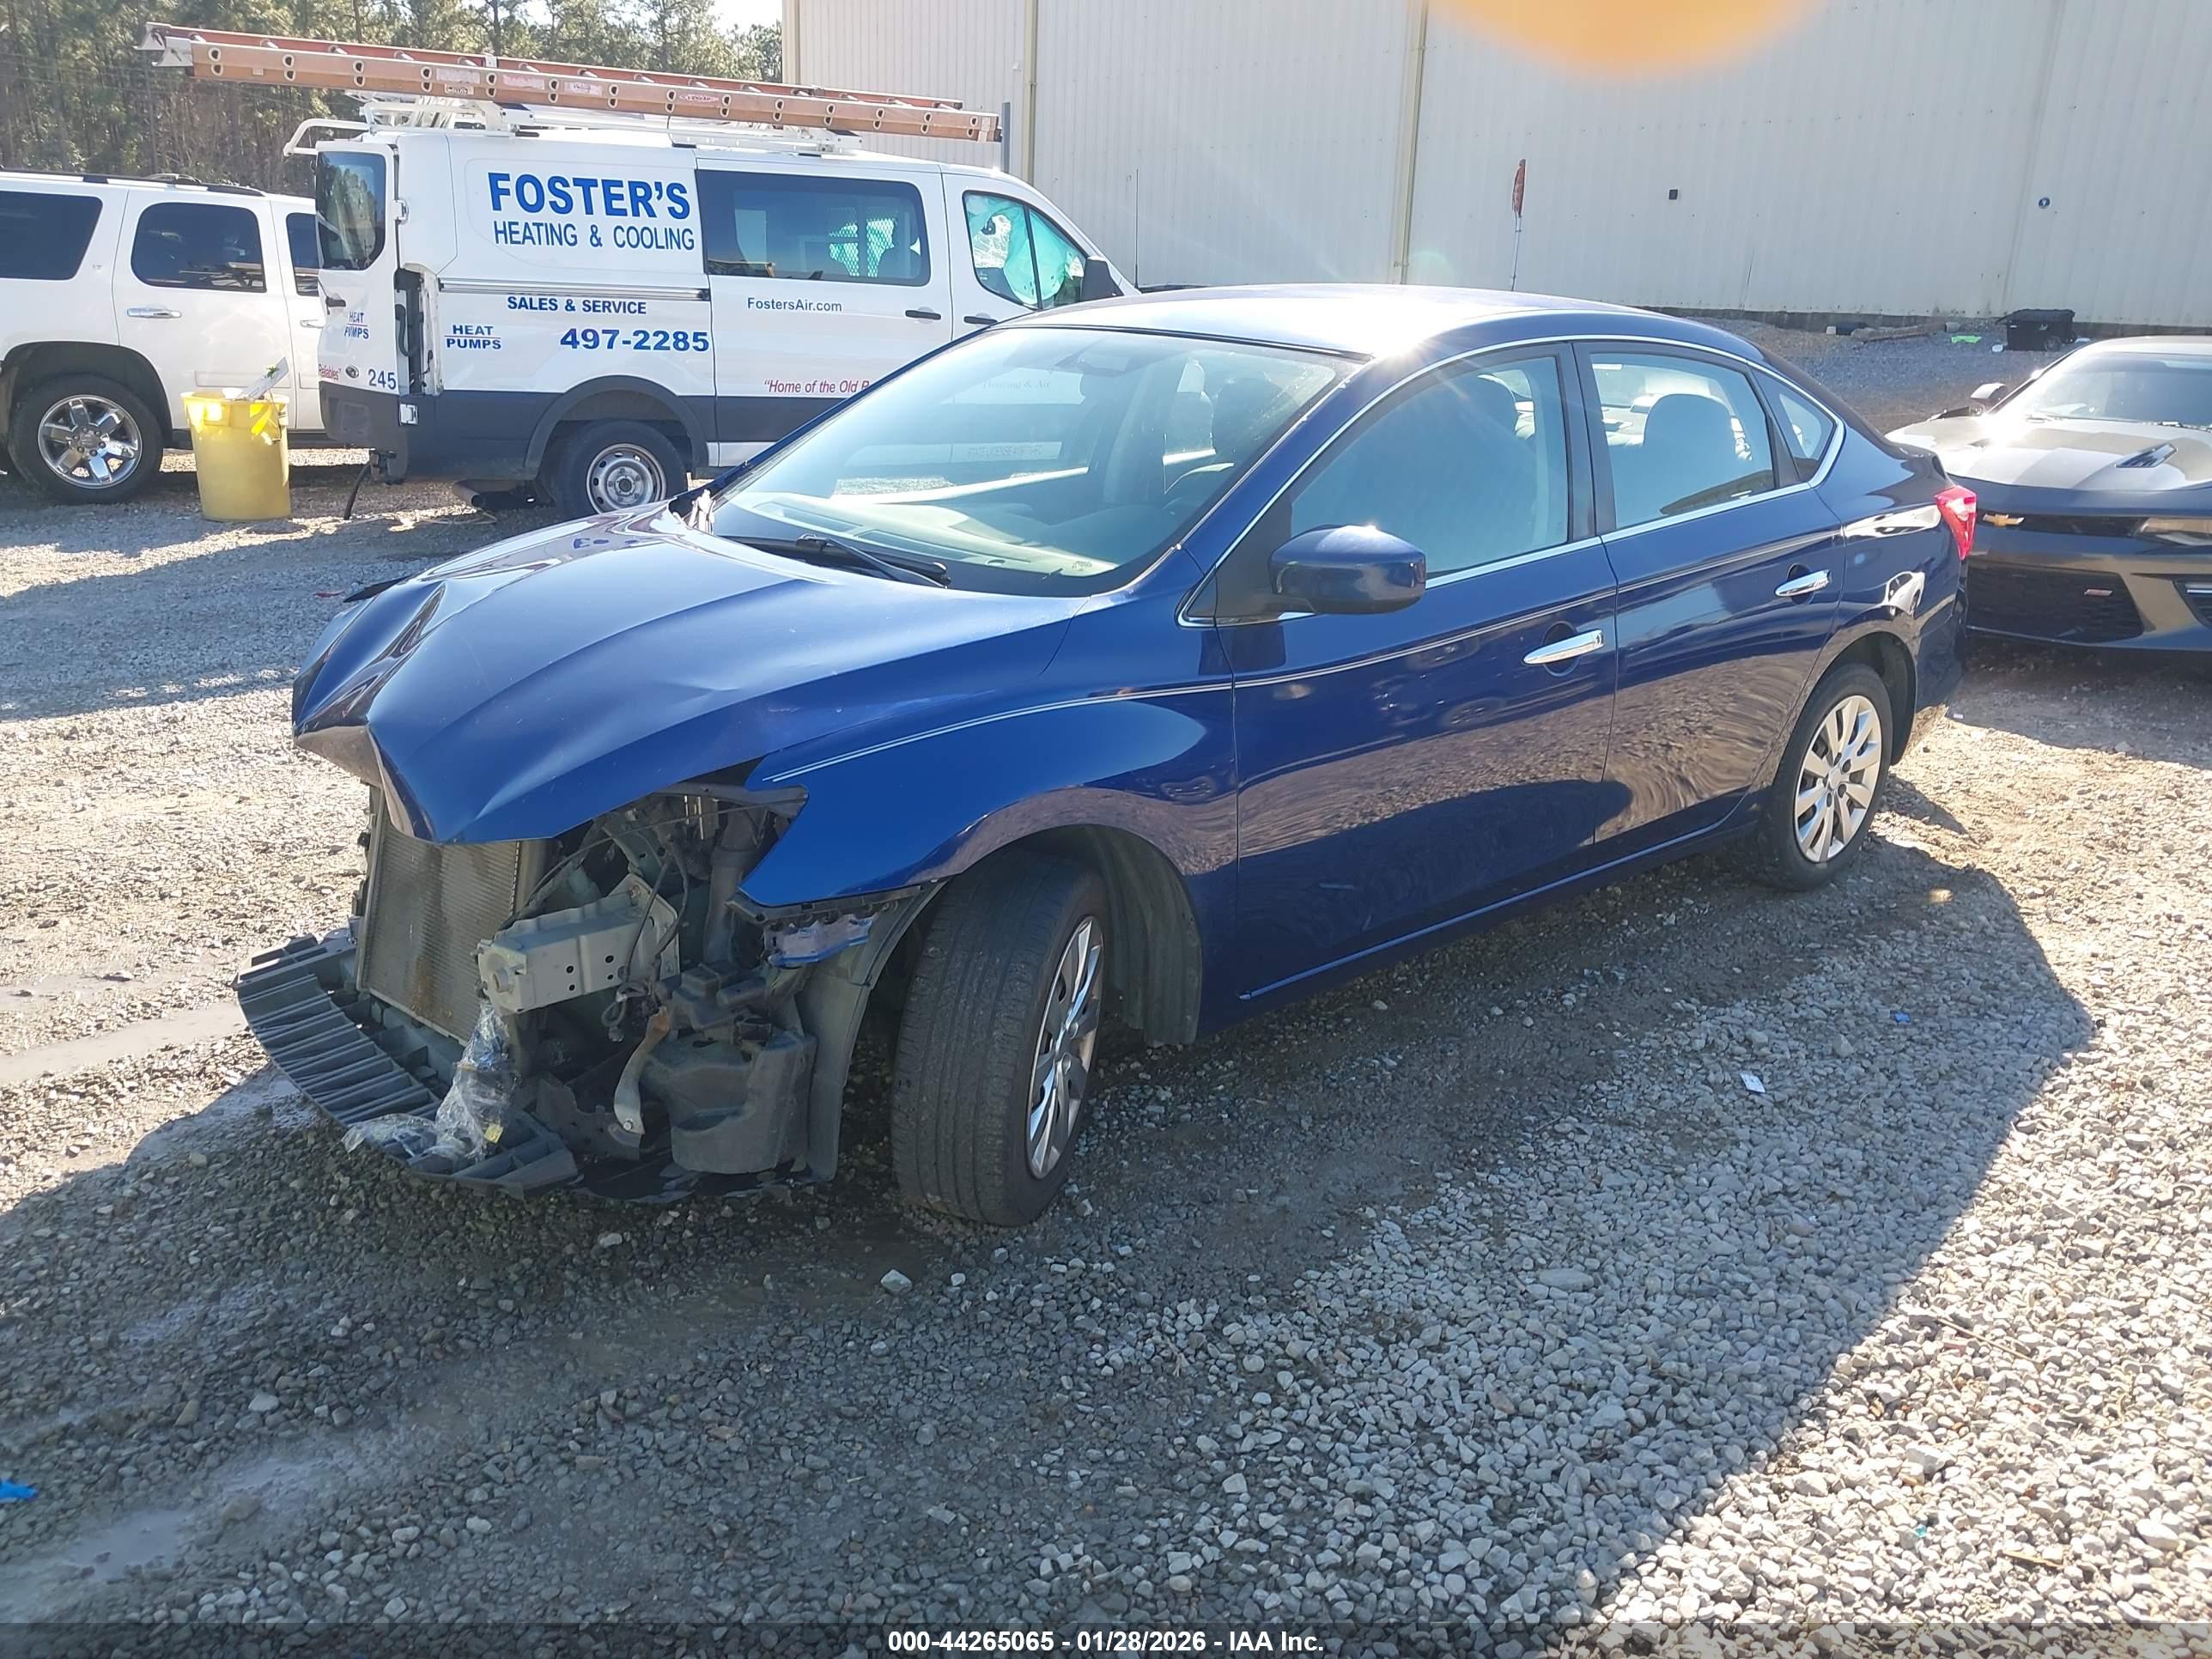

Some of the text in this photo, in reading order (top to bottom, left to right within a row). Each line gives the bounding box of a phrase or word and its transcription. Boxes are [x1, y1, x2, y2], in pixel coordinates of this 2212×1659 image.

[488, 172, 690, 220] FOSTER'S
[494, 220, 695, 251] HEATING & COOLING
[507, 295, 647, 315] SALES & SERVICE
[747, 297, 842, 312] FostersAir.com
[349, 311, 365, 324] HEAT
[343, 326, 369, 340] PUMPS
[453, 324, 494, 336] HEAT
[447, 337, 501, 349] PUMPS
[560, 328, 709, 352] 497-2285
[368, 368, 397, 391] 245
[805, 380, 817, 393] of
[818, 380, 836, 393] the
[839, 380, 859, 393] Old
